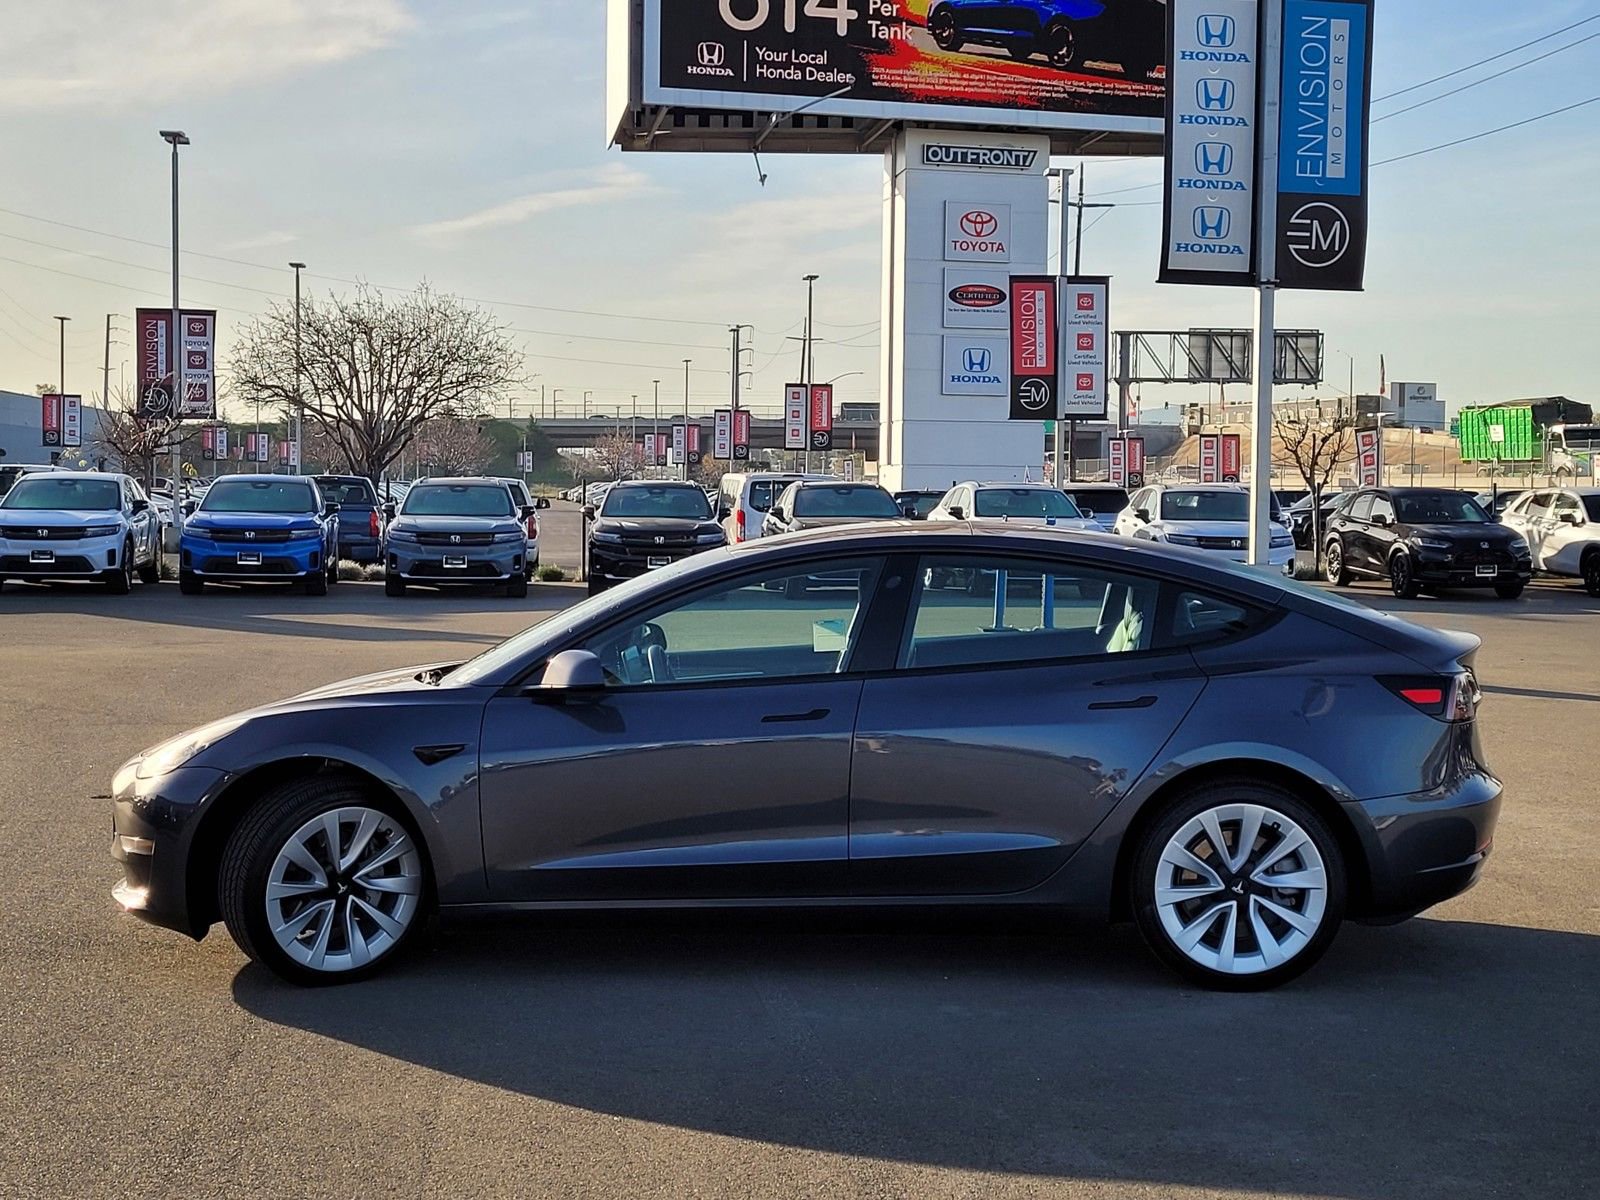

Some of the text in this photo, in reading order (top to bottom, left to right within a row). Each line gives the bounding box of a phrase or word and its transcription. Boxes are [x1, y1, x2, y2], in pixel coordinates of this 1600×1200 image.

[869, 0, 901, 17] Per
[868, 21, 913, 41] Tank
[755, 46, 828, 65] Your Local
[1180, 51, 1251, 63] HONDA
[687, 65, 735, 77] HONDA
[756, 65, 801, 81] Honda
[1296, 16, 1328, 178] ENVISION
[1331, 33, 1345, 165] MOTORS
[1178, 114, 1250, 127] HONDA
[1177, 178, 1248, 191] HONDA
[951, 240, 1006, 253] TOYOTA
[1175, 242, 1245, 255] HONDA
[1020, 289, 1036, 368] ENVISION
[146, 320, 158, 379] ENVISION
[951, 375, 1002, 384] HONDA
